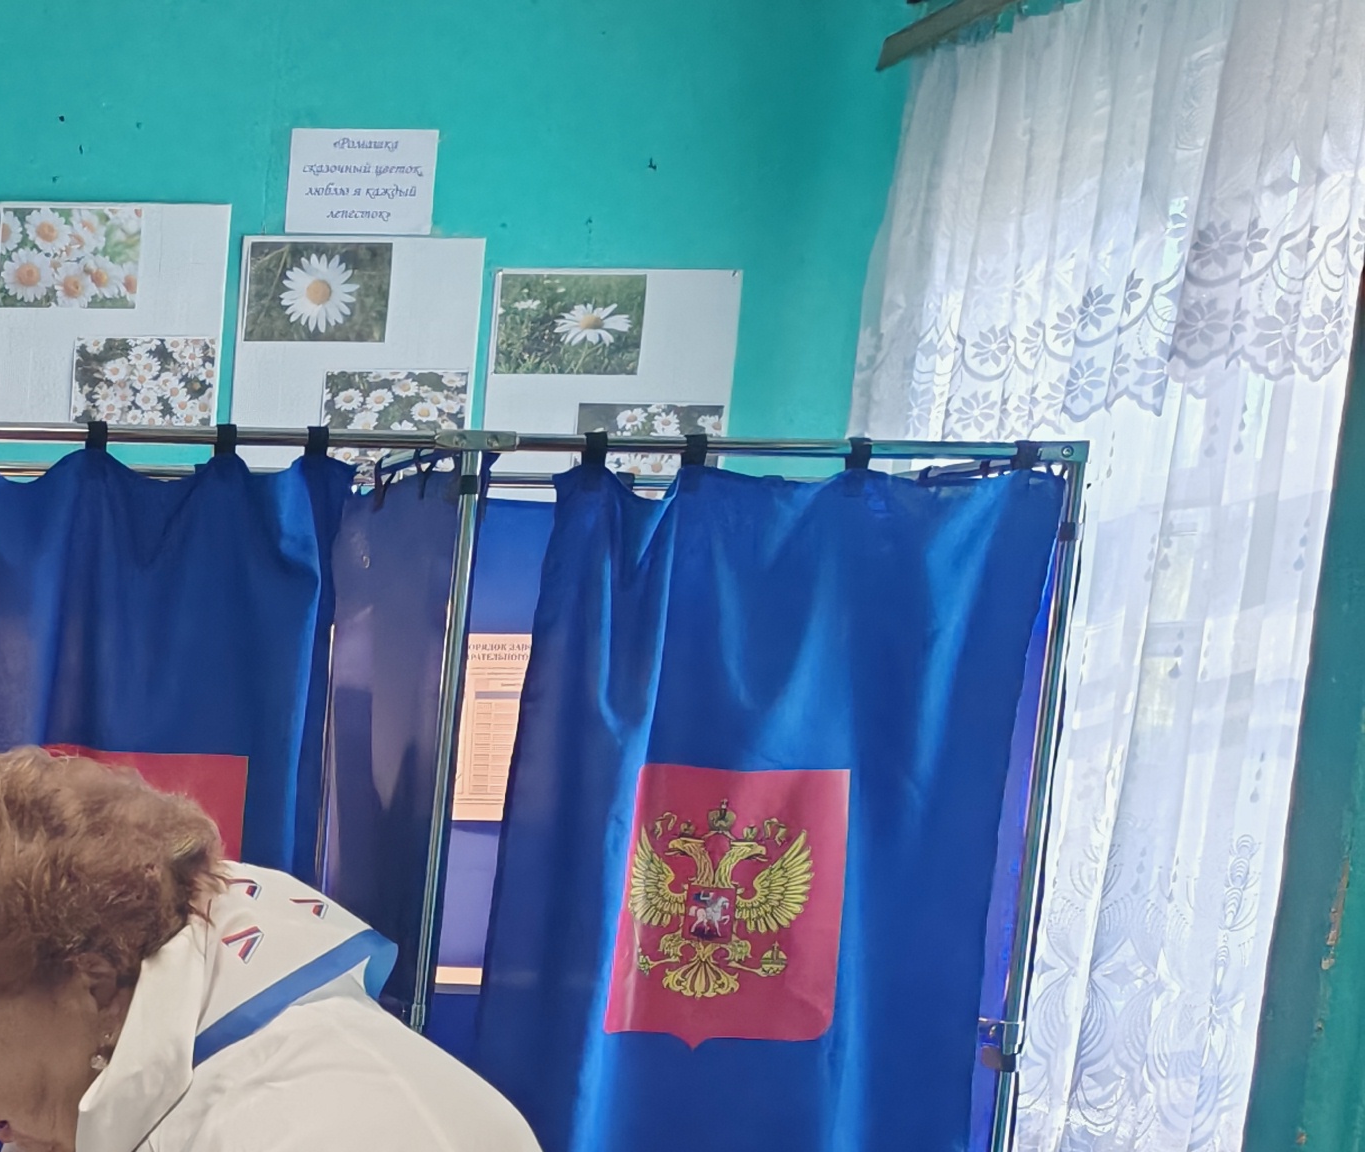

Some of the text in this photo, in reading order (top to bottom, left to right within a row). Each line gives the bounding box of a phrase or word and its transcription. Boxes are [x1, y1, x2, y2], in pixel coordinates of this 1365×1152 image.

[303, 162, 371, 176] сказочный
[305, 183, 417, 199] люблю я каждый
[469, 643, 507, 651] ОРЯДОК
[468, 653, 529, 661] РАТЕЛЬНОГО
